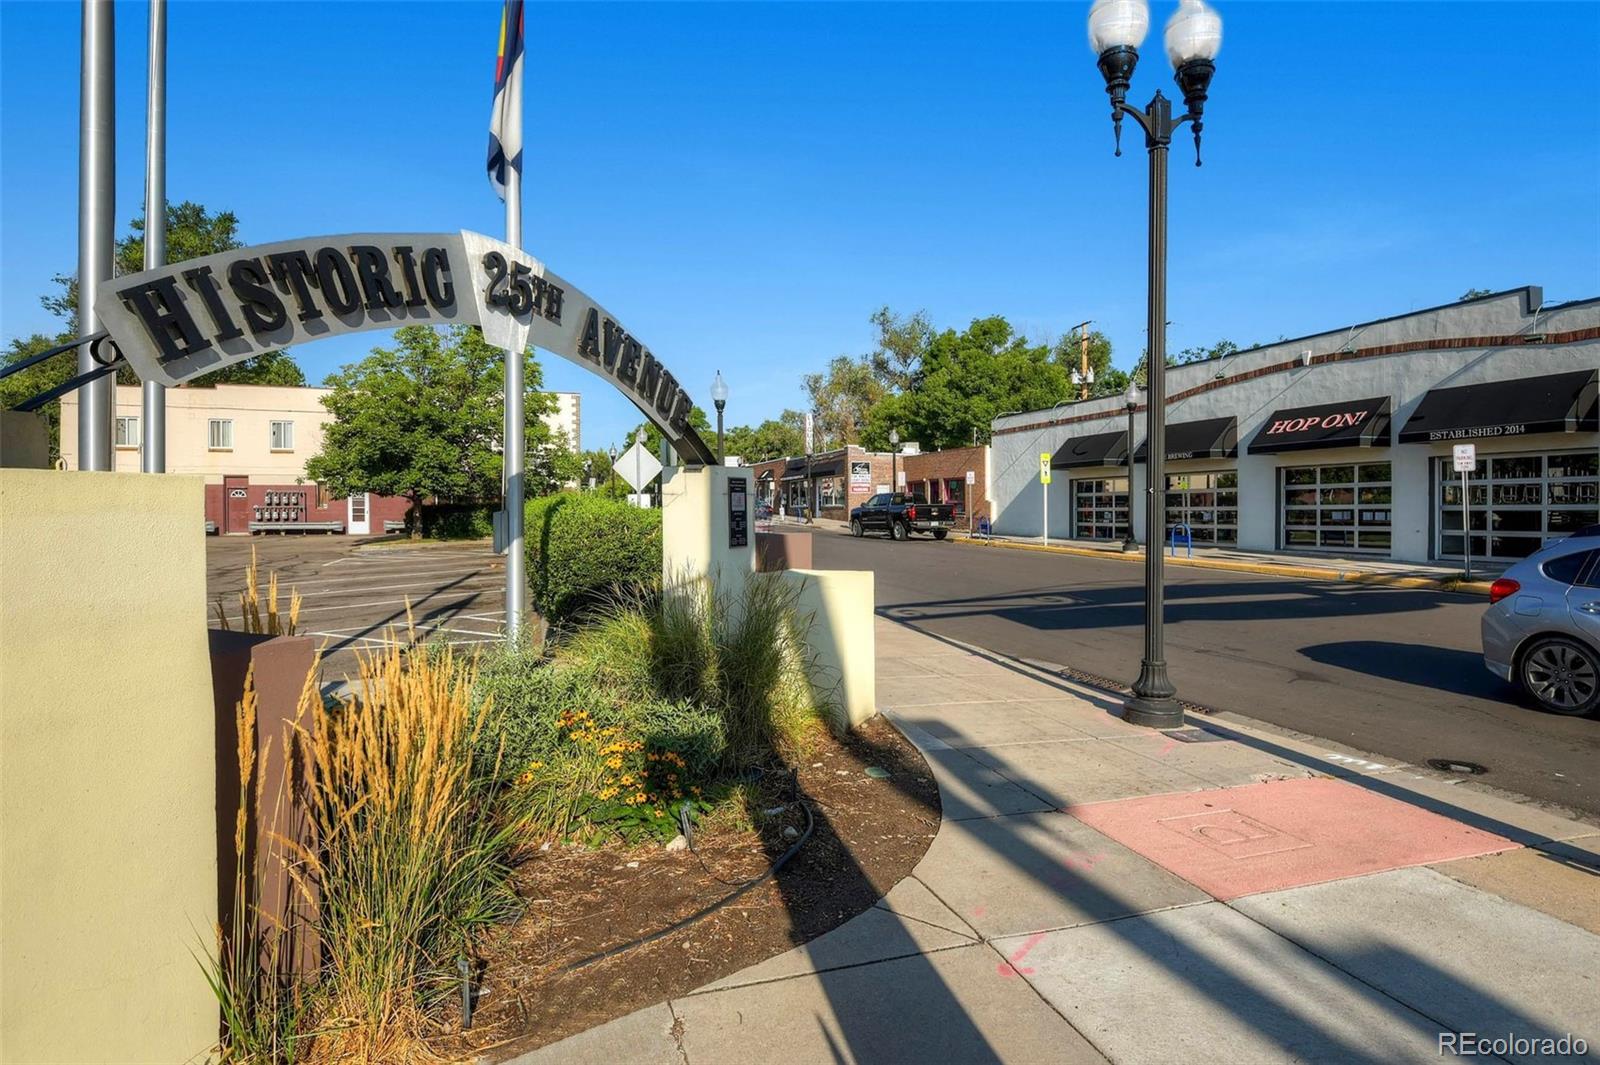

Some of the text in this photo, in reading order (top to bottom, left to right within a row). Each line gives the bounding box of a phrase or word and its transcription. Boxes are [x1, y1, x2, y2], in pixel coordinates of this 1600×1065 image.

[116, 245, 694, 433] HISTORIC 25TH AVENUE
[1266, 410, 1367, 435] HOP ON!
[1430, 425, 1525, 440] ESTABLISHED 2014
[1168, 451, 1193, 459] BREWING
